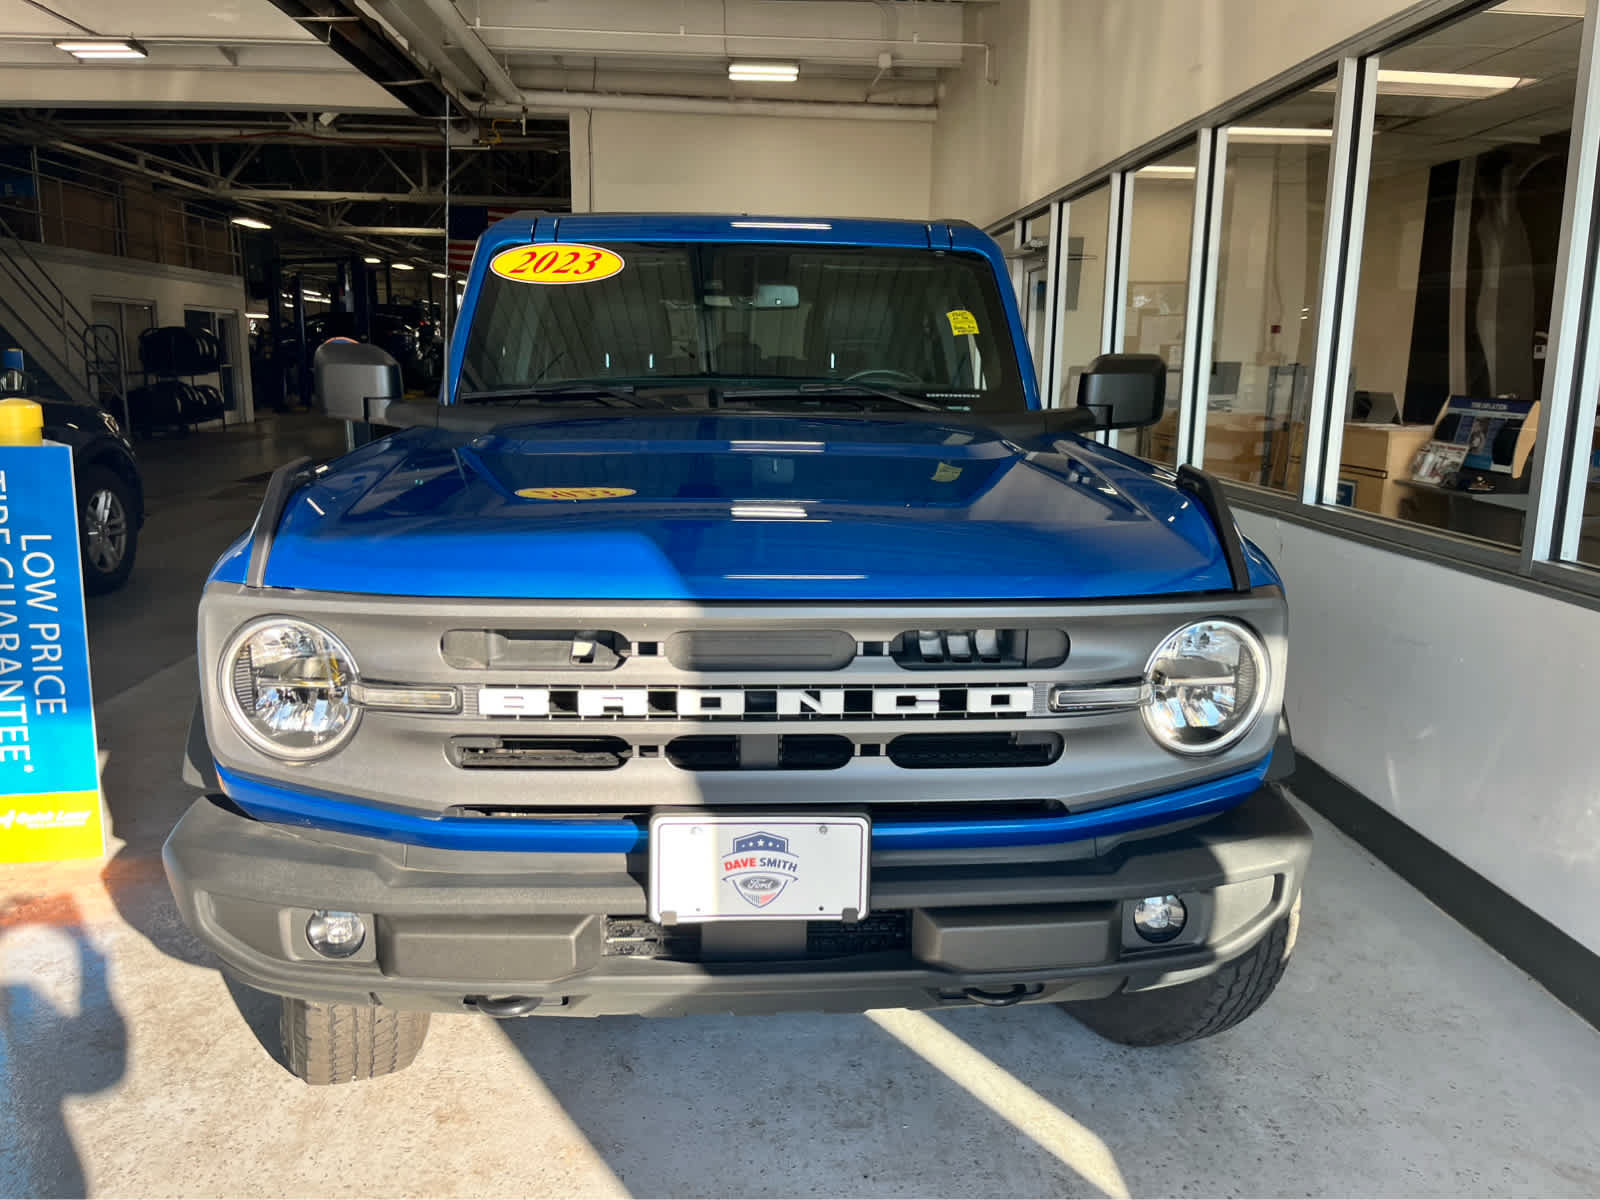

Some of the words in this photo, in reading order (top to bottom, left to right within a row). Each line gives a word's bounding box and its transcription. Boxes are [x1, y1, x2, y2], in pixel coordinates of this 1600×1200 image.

[509, 252, 601, 274] 2023
[21, 534, 58, 612] LOW
[29, 623, 67, 715] PRICE
[479, 688, 1034, 716] BRONCO
[724, 857, 757, 872] DAVE
[759, 856, 798, 873] SMITH
[747, 877, 774, 890] Ford
